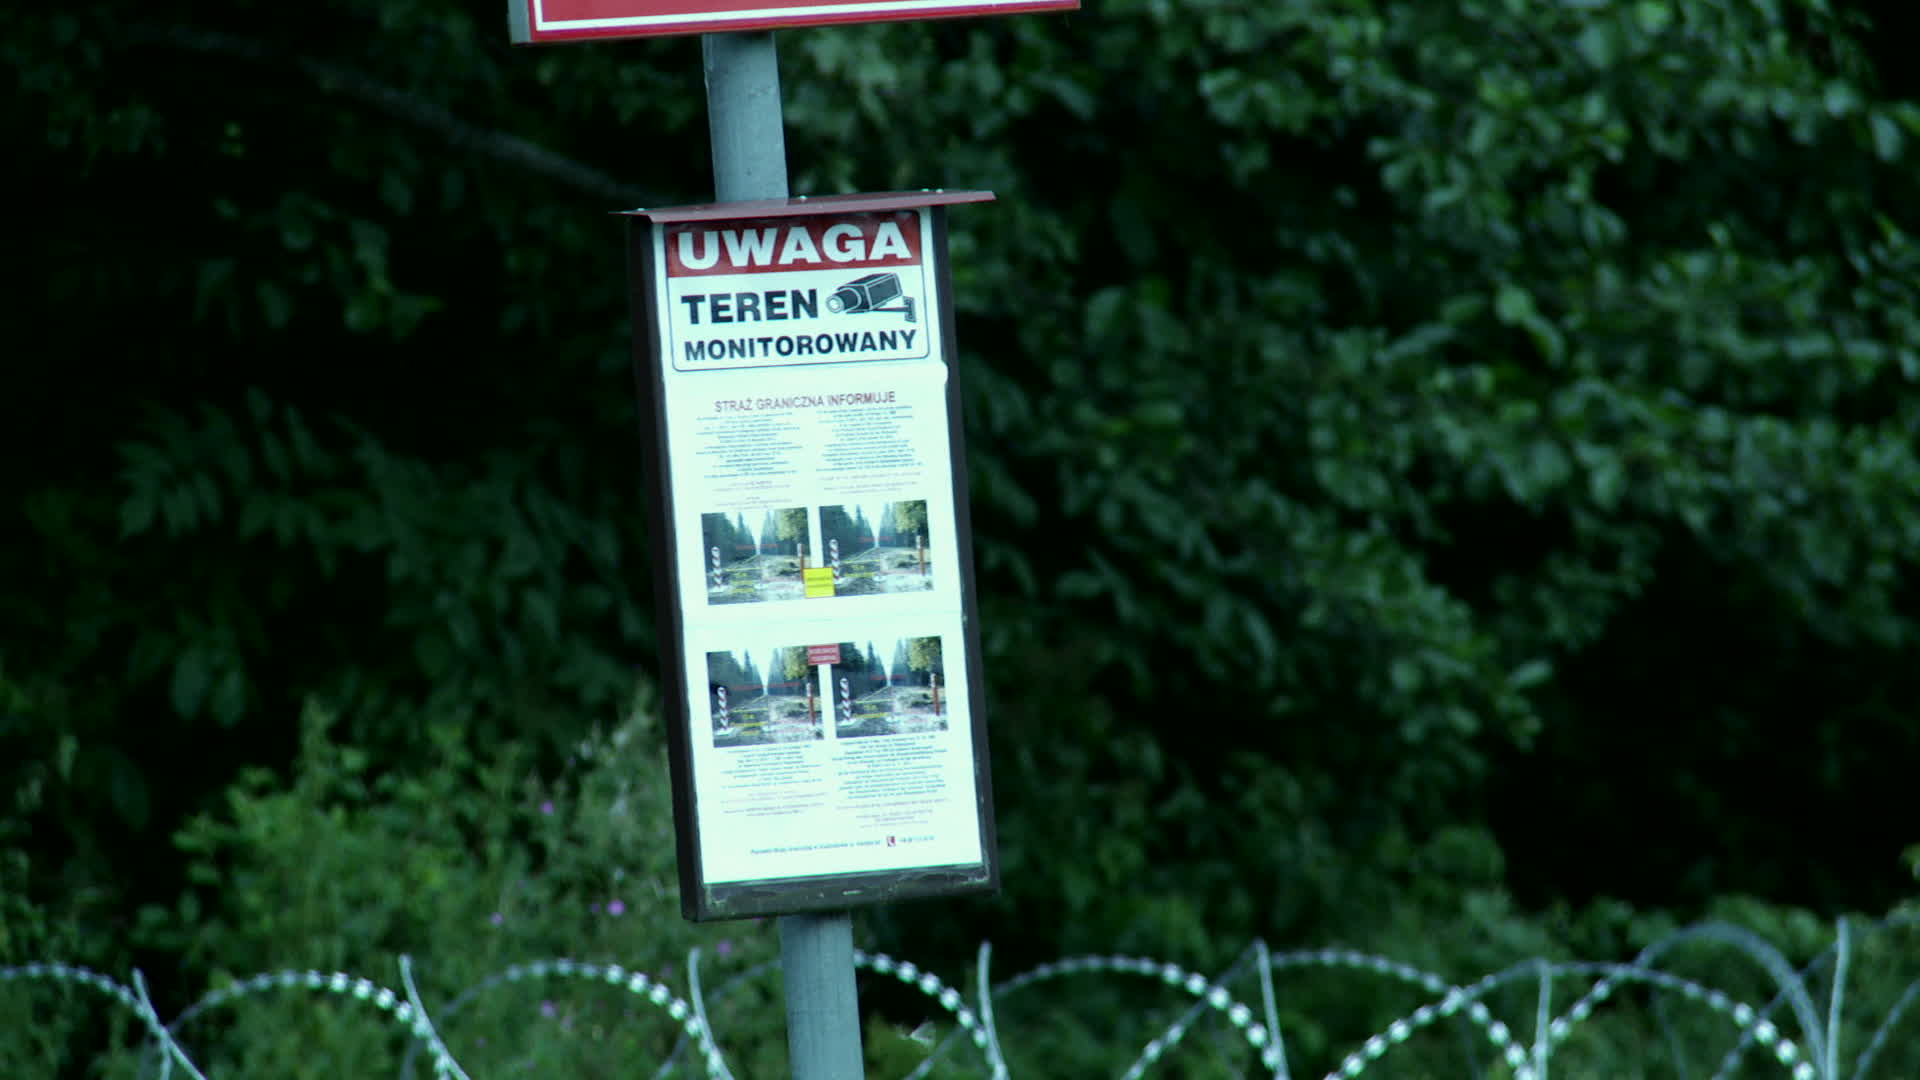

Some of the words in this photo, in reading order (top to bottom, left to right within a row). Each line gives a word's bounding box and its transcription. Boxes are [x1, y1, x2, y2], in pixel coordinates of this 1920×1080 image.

[677, 221, 912, 271] UWAGA
[681, 289, 818, 325] TEREN
[684, 329, 917, 361] MONITOROWANY
[715, 397, 752, 412] STRAŻ
[756, 395, 824, 410] GRANICZNA
[827, 391, 896, 406] INFORMUJE
